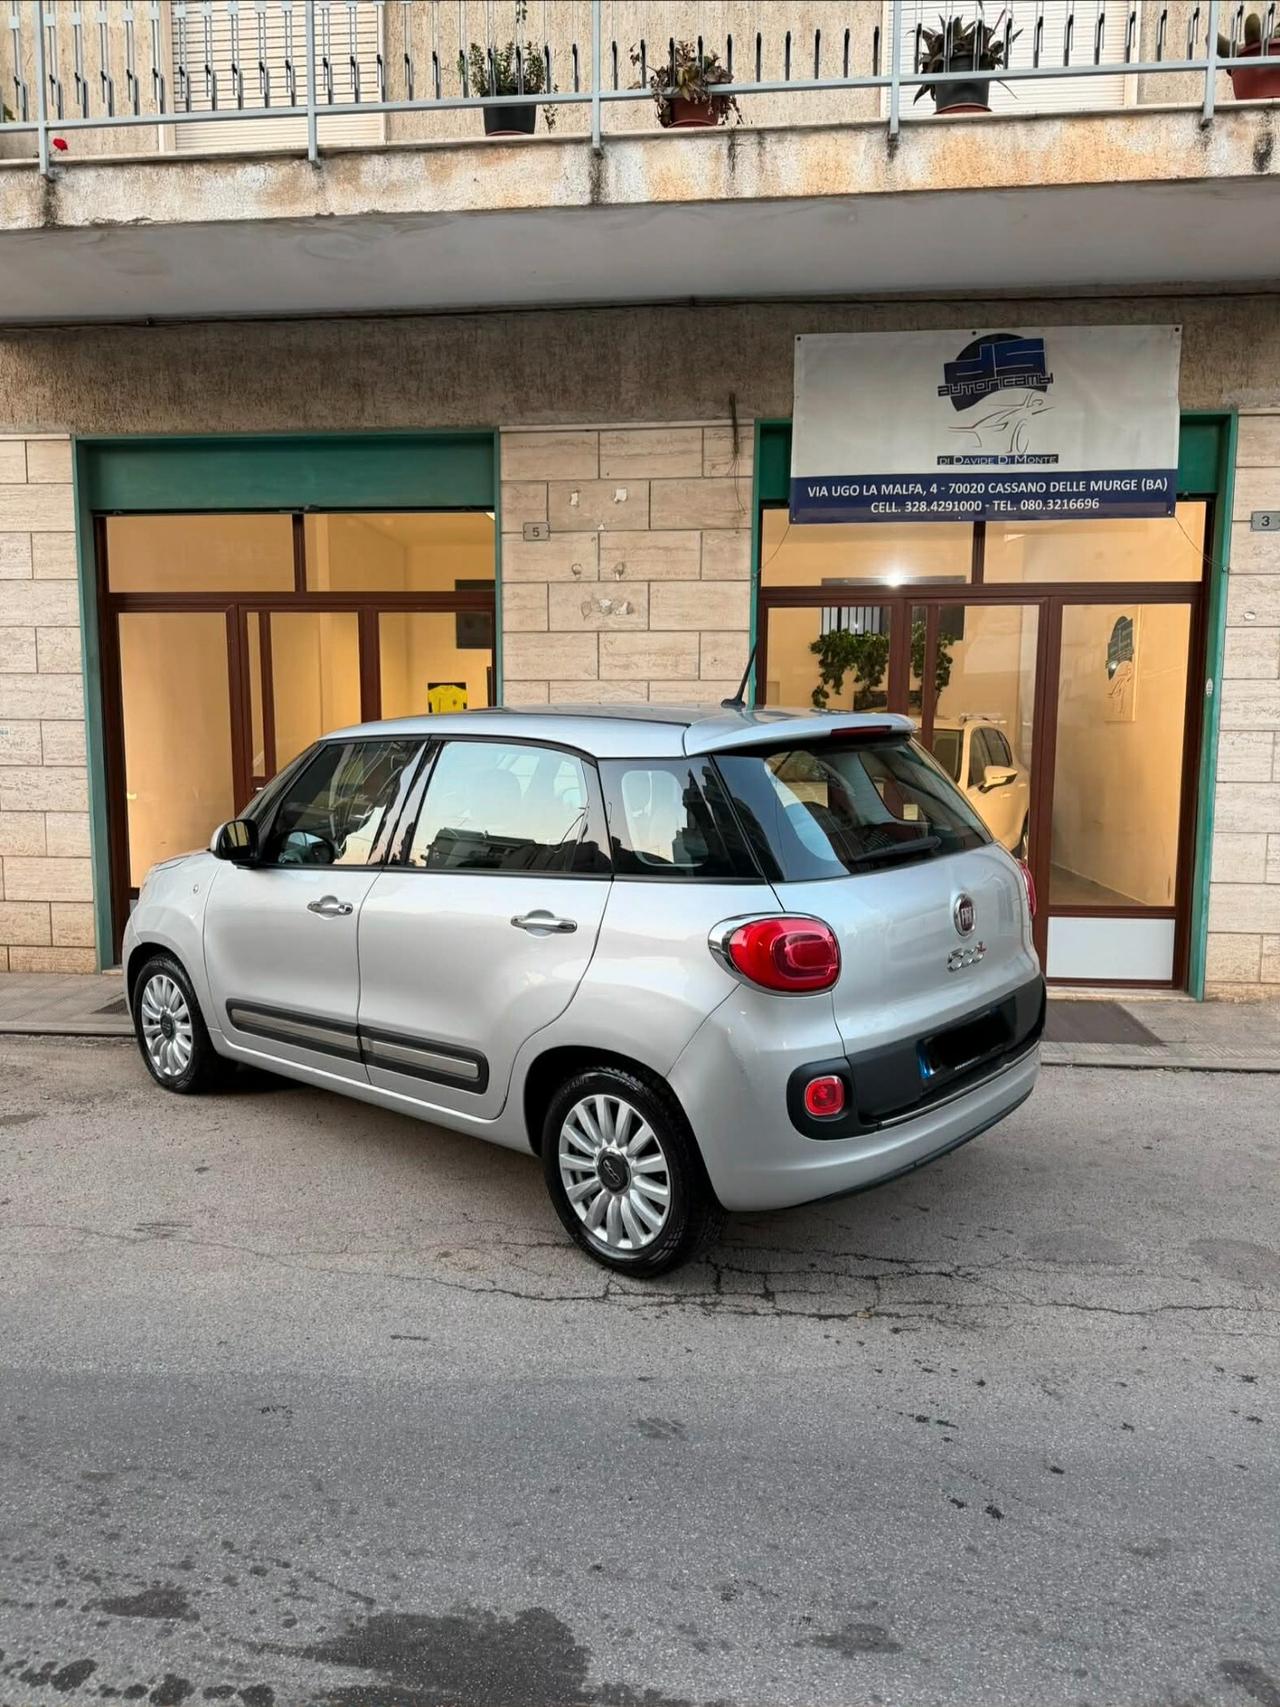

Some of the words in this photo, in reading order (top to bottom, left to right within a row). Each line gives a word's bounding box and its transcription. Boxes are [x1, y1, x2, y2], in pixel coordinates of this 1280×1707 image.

[808, 486, 828, 497] VIA
[832, 485, 859, 497] UGO
[864, 485, 878, 496] LA
[882, 484, 926, 498] MALFA,
[930, 484, 938, 494] 4
[949, 483, 985, 494] 70020
[989, 482, 1046, 494] CASSANO
[1050, 481, 1086, 493] DELLE
[1090, 479, 1137, 492] MURGE
[1141, 477, 1168, 492] (BA)
[871, 501, 901, 513] CELL.
[904, 500, 982, 513] 328.4291000
[993, 501, 1017, 511] TEL.
[1021, 498, 1100, 511] 080.3216696
[1261, 515, 1270, 527] 3
[532, 527, 540, 538] 5
